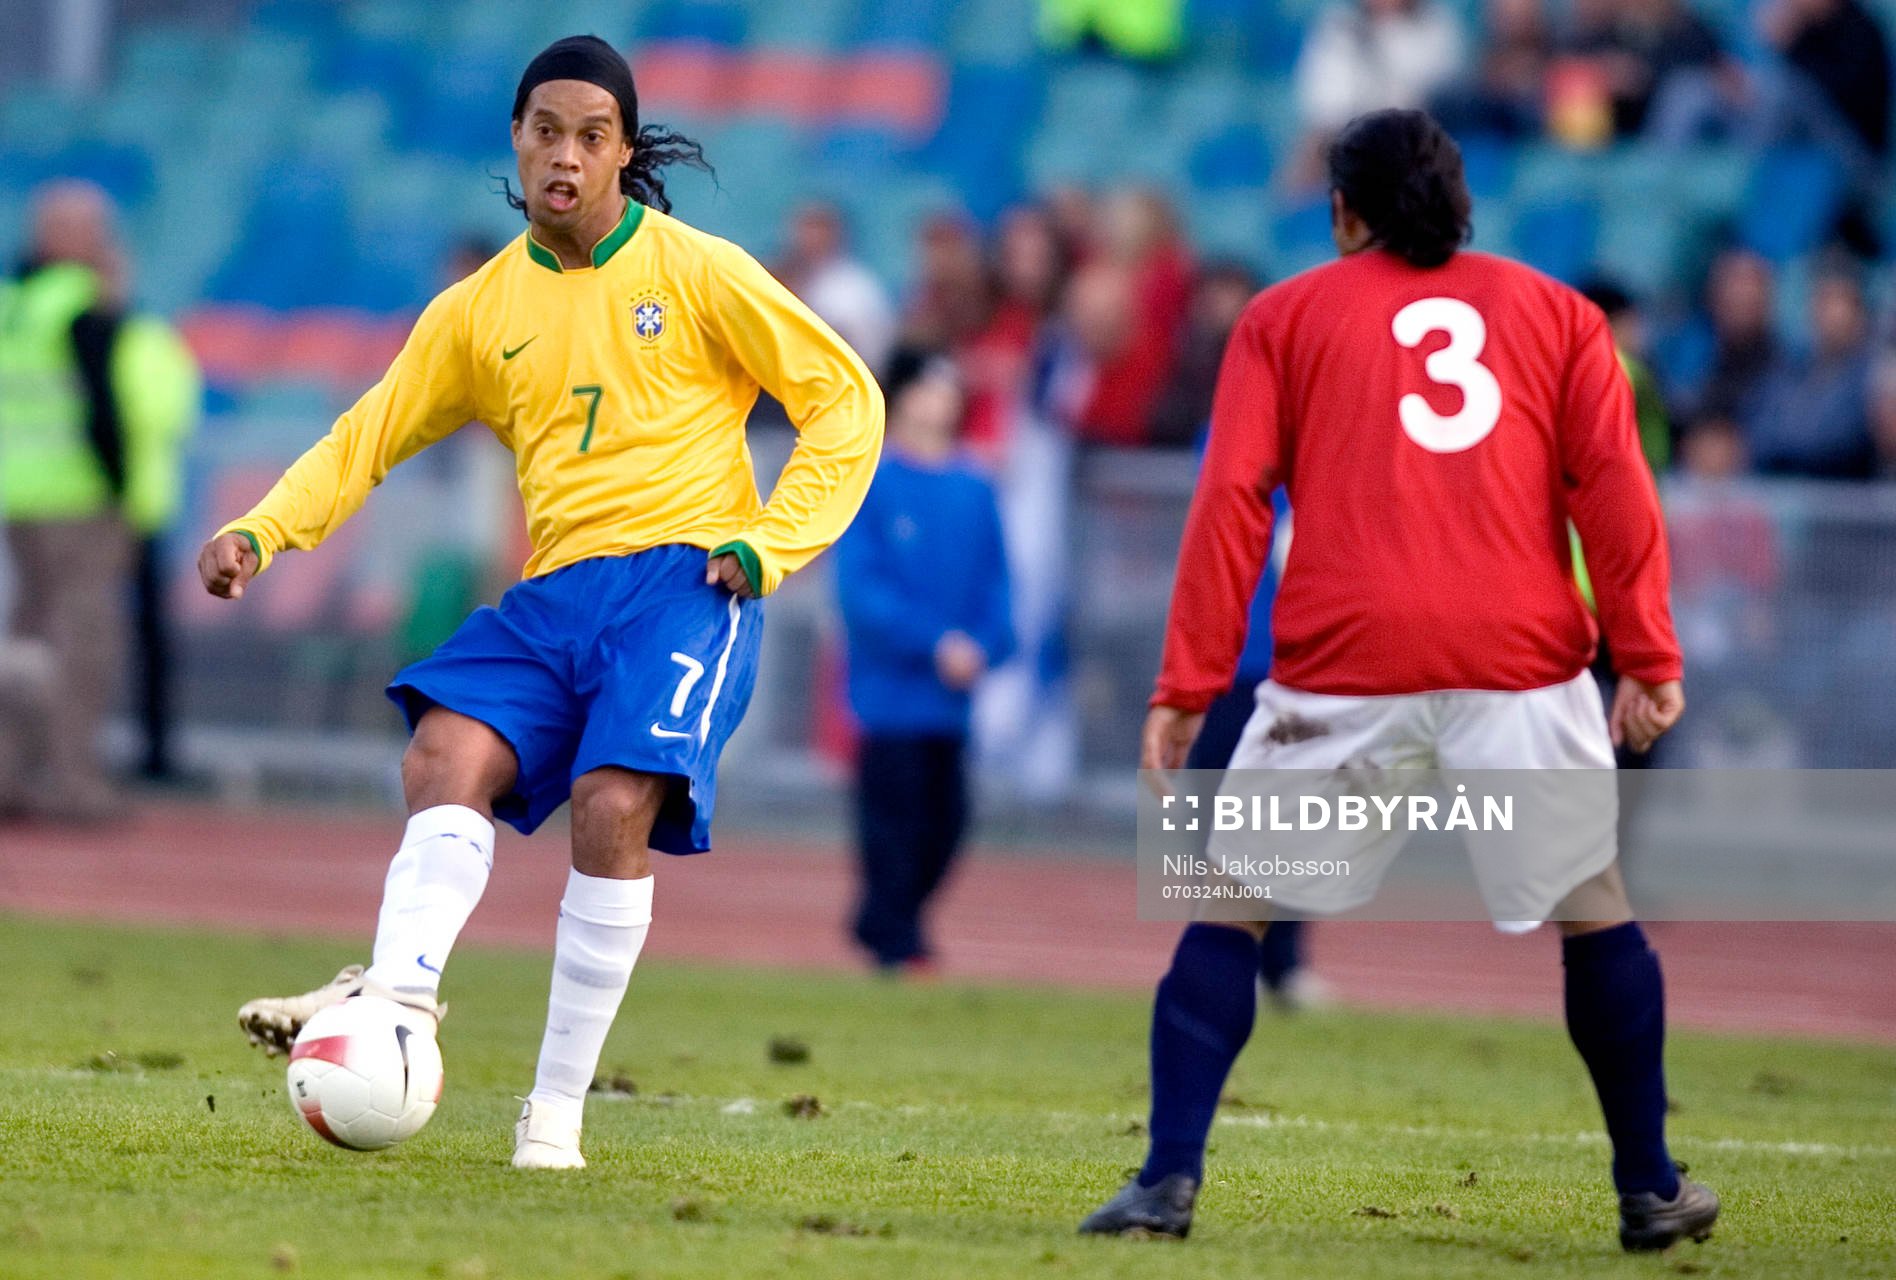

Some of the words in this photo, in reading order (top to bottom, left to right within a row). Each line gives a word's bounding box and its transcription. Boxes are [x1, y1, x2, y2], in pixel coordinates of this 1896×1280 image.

[1391, 297, 1503, 452] 3
[572, 385, 603, 453] 7
[670, 651, 704, 718] 7
